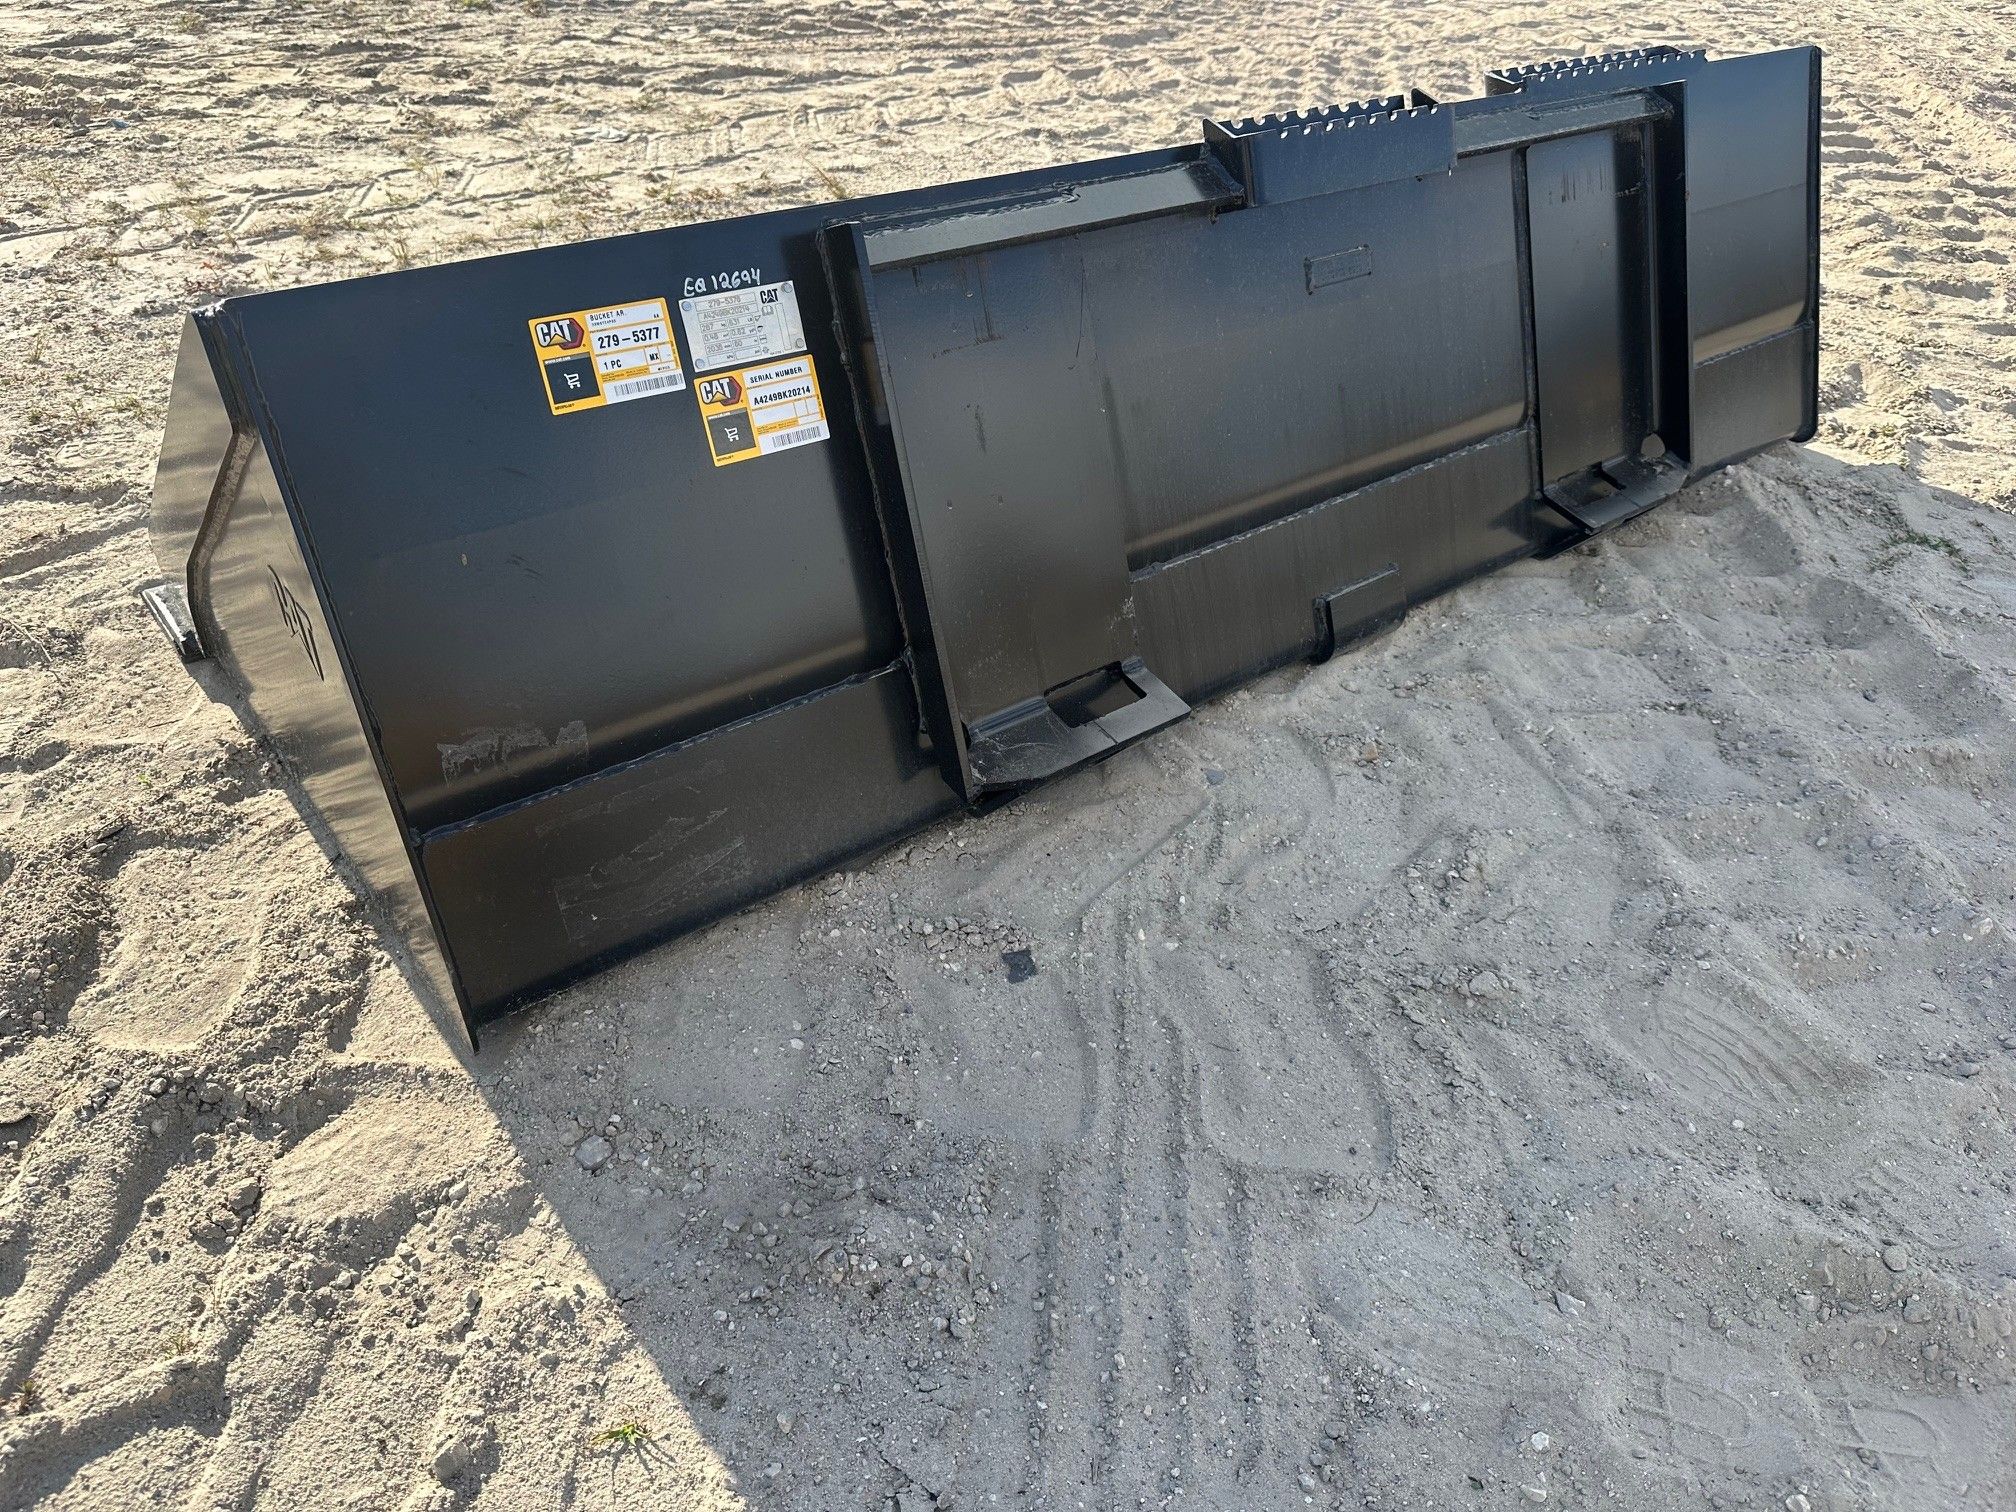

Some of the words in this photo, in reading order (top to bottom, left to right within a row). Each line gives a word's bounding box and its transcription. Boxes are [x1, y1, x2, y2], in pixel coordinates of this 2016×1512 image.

[711, 267, 760, 290] 12694
[760, 288, 778, 304] CAT
[589, 311, 613, 322] BUCKET
[536, 319, 572, 347] CAT
[604, 362, 609, 370] 1
[611, 359, 622, 369] PC
[649, 352, 660, 361] MX
[750, 371, 773, 383] SERIAL
[775, 366, 803, 377] NUMBER
[699, 378, 731, 404] CAT
[753, 385, 811, 406] A4249BK20214
